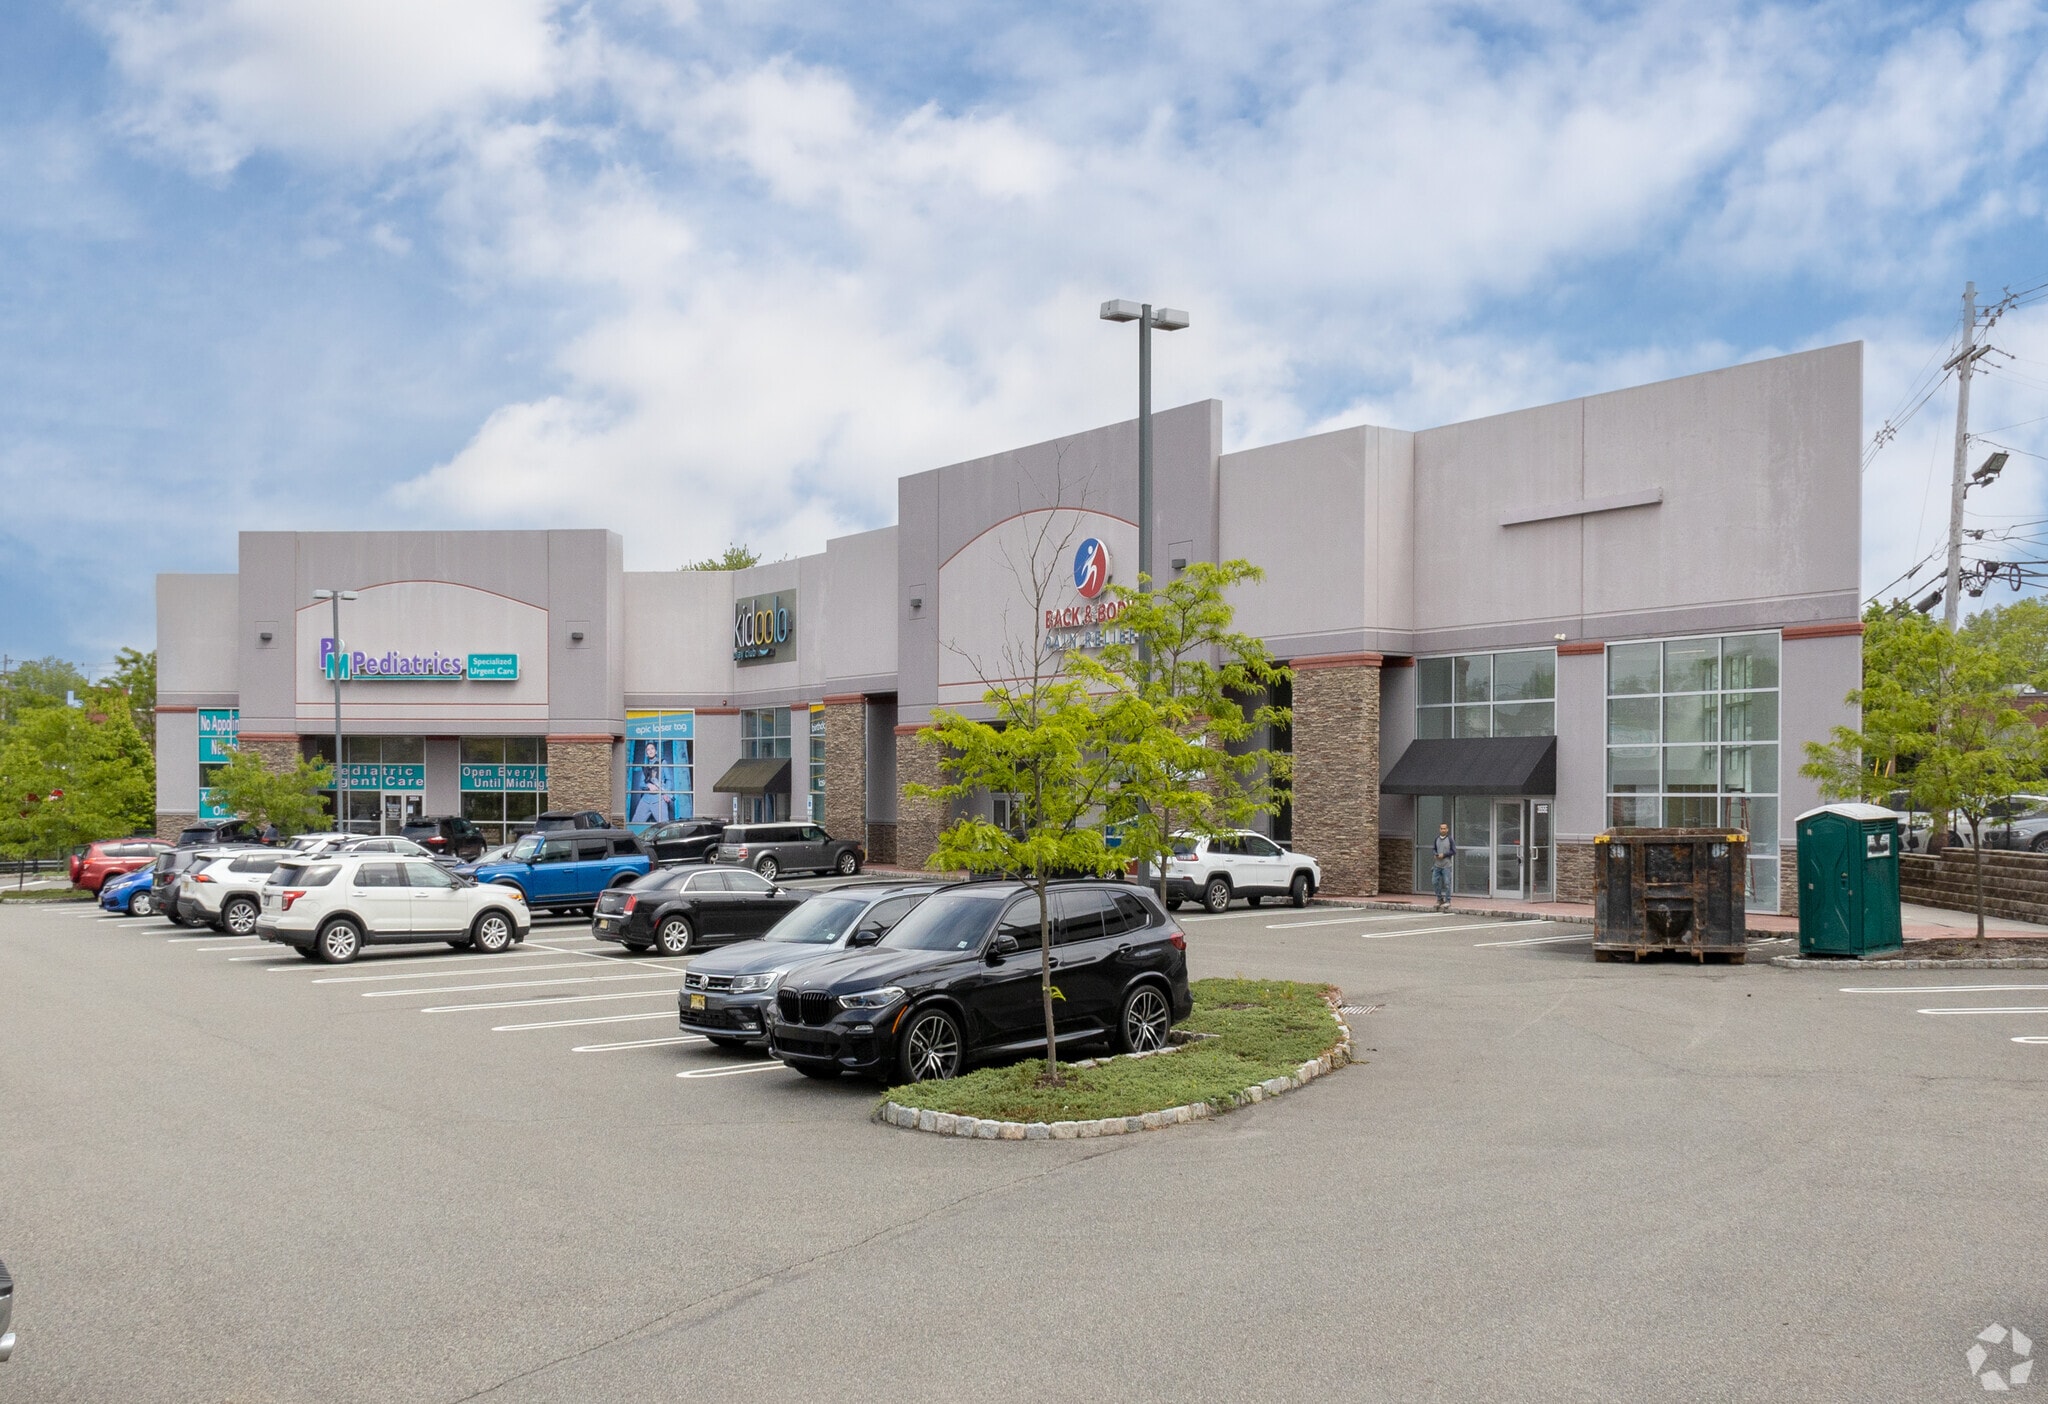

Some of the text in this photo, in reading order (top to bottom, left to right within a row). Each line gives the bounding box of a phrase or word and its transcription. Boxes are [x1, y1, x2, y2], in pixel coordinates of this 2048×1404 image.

[1045, 600, 1135, 629] BACK & BOD
[1045, 627, 1136, 651] PAIN RELIEF
[352, 651, 462, 674] Pediatrics
[472, 657, 512, 667] Specialized
[470, 667, 515, 677] Urgent Care
[200, 714, 211, 731] No
[635, 723, 687, 736] epic laser tag
[332, 766, 414, 776] ediatric
[463, 767, 492, 779] Open
[498, 766, 536, 779] Every
[331, 776, 424, 788] rgent Care
[474, 778, 501, 788] Until
